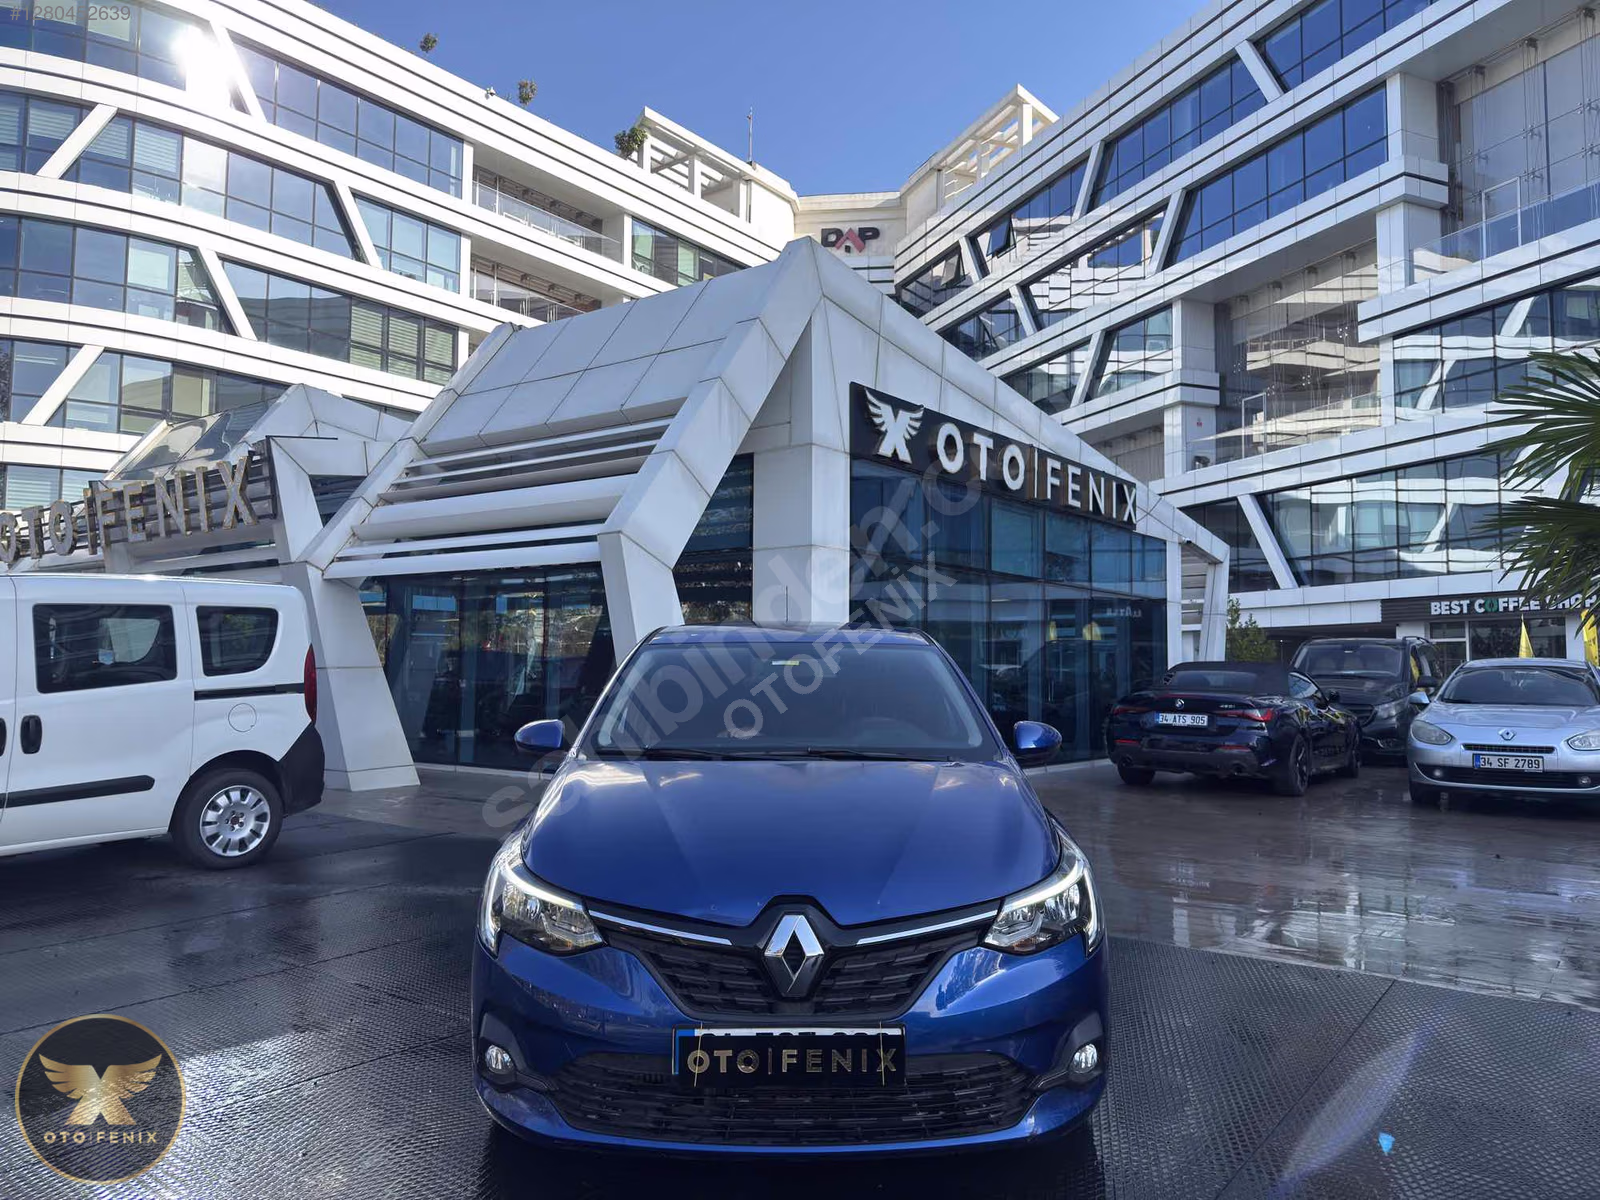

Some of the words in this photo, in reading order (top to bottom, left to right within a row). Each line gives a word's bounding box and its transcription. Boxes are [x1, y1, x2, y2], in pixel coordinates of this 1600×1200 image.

[1430, 599, 1470, 616] BEST
[1159, 714, 1169, 723] 34
[1173, 715, 1187, 724] ATS
[1190, 716, 1206, 725] 905
[1481, 757, 1493, 767] 34
[1497, 757, 1510, 768] SF
[1514, 758, 1540, 769] 2789
